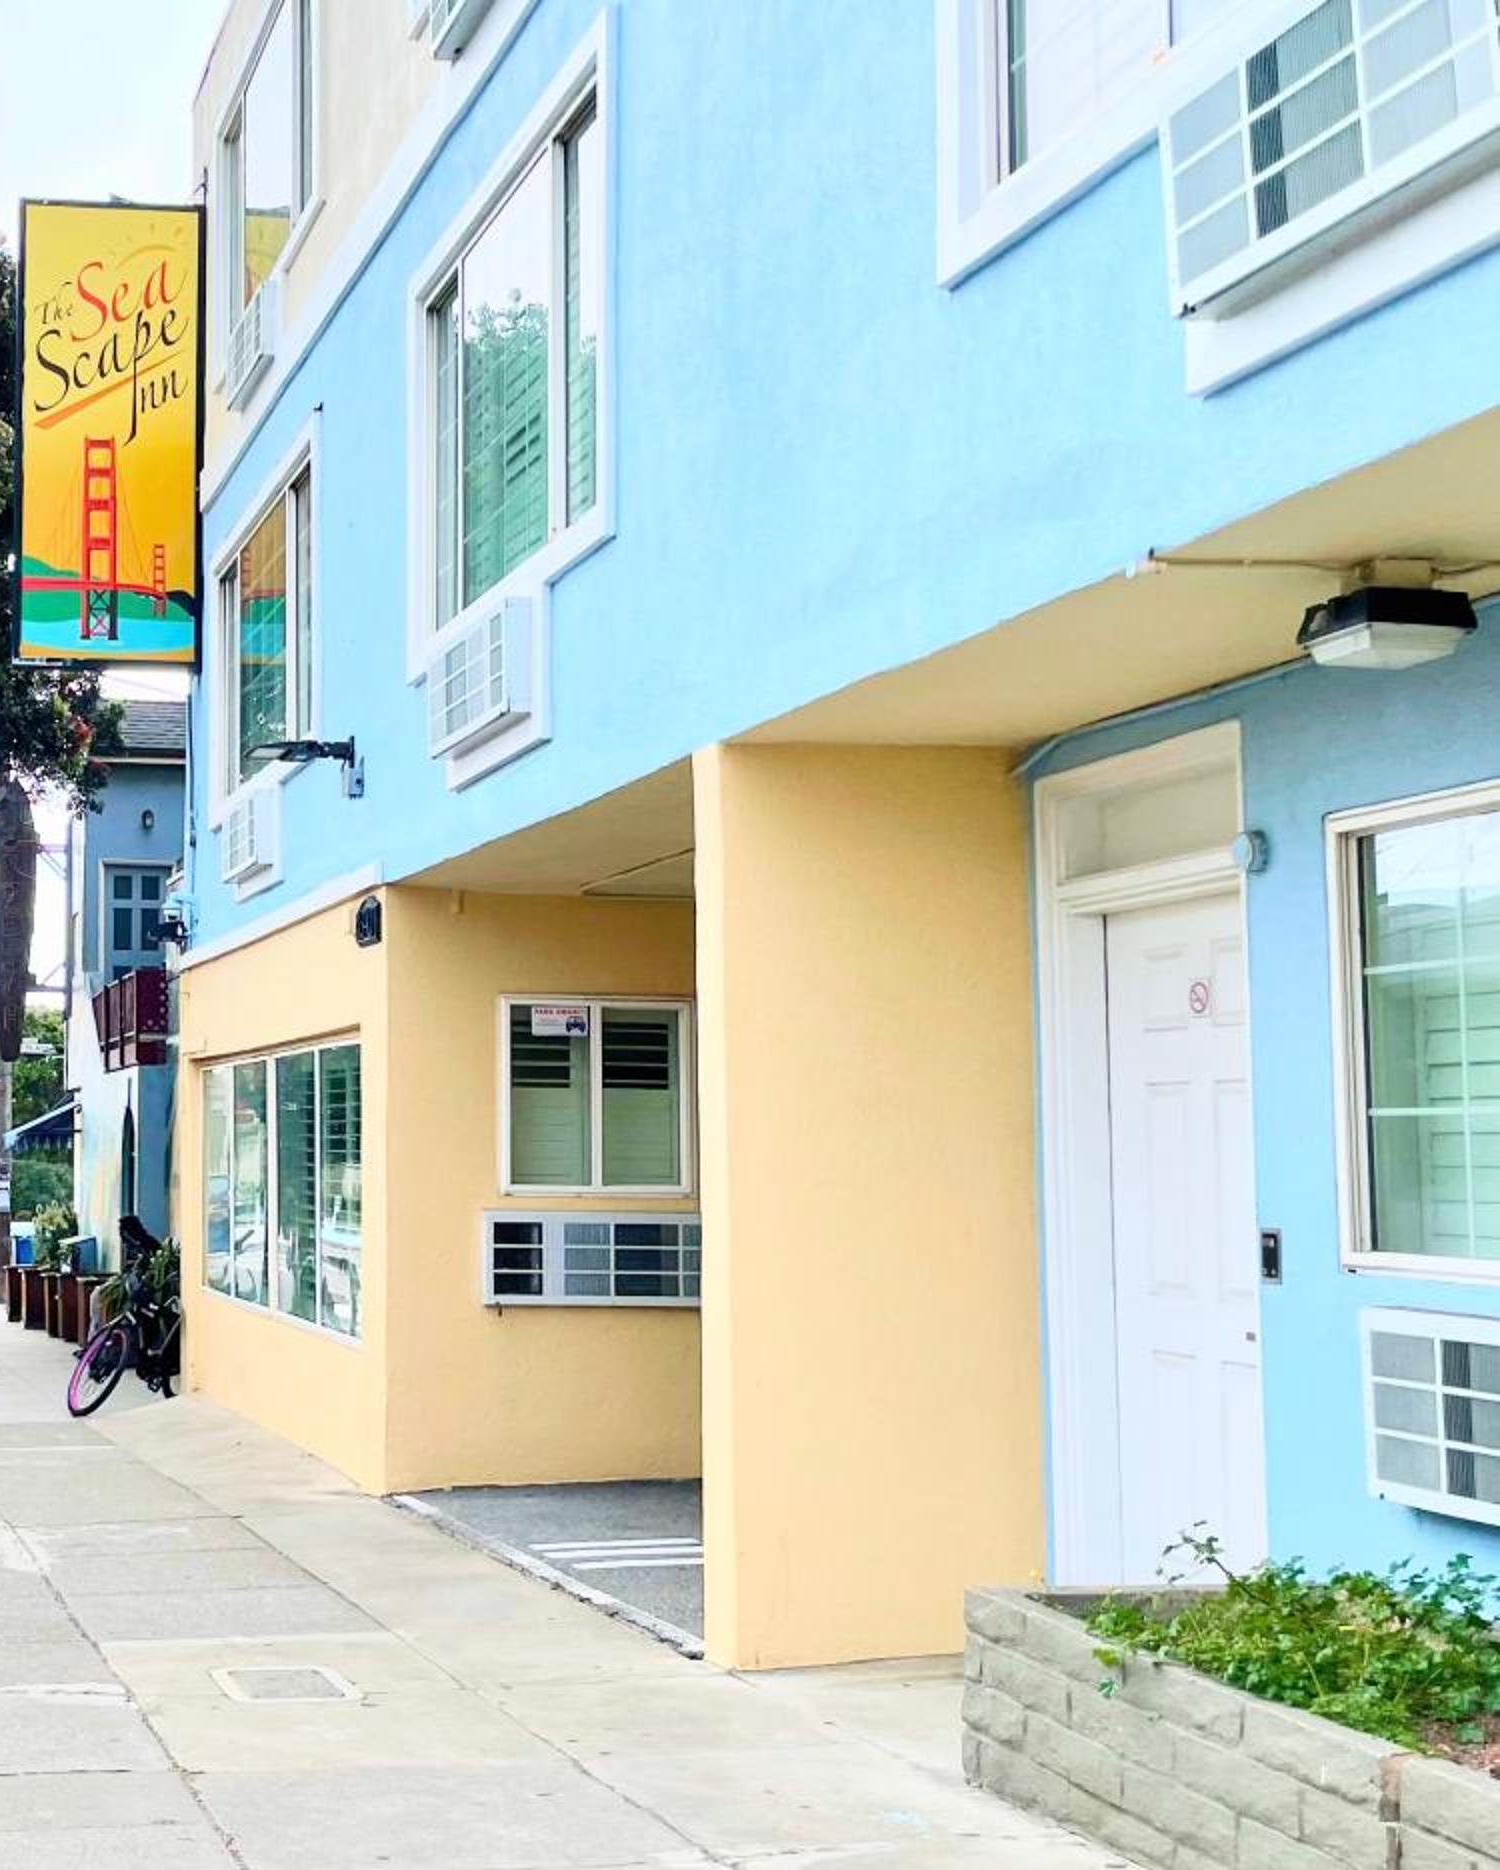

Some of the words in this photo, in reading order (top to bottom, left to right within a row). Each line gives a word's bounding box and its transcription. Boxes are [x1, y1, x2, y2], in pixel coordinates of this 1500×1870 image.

[34, 281, 73, 325] The
[70, 261, 188, 343] Sea
[34, 309, 190, 413] Scape
[122, 368, 189, 448] Inn
